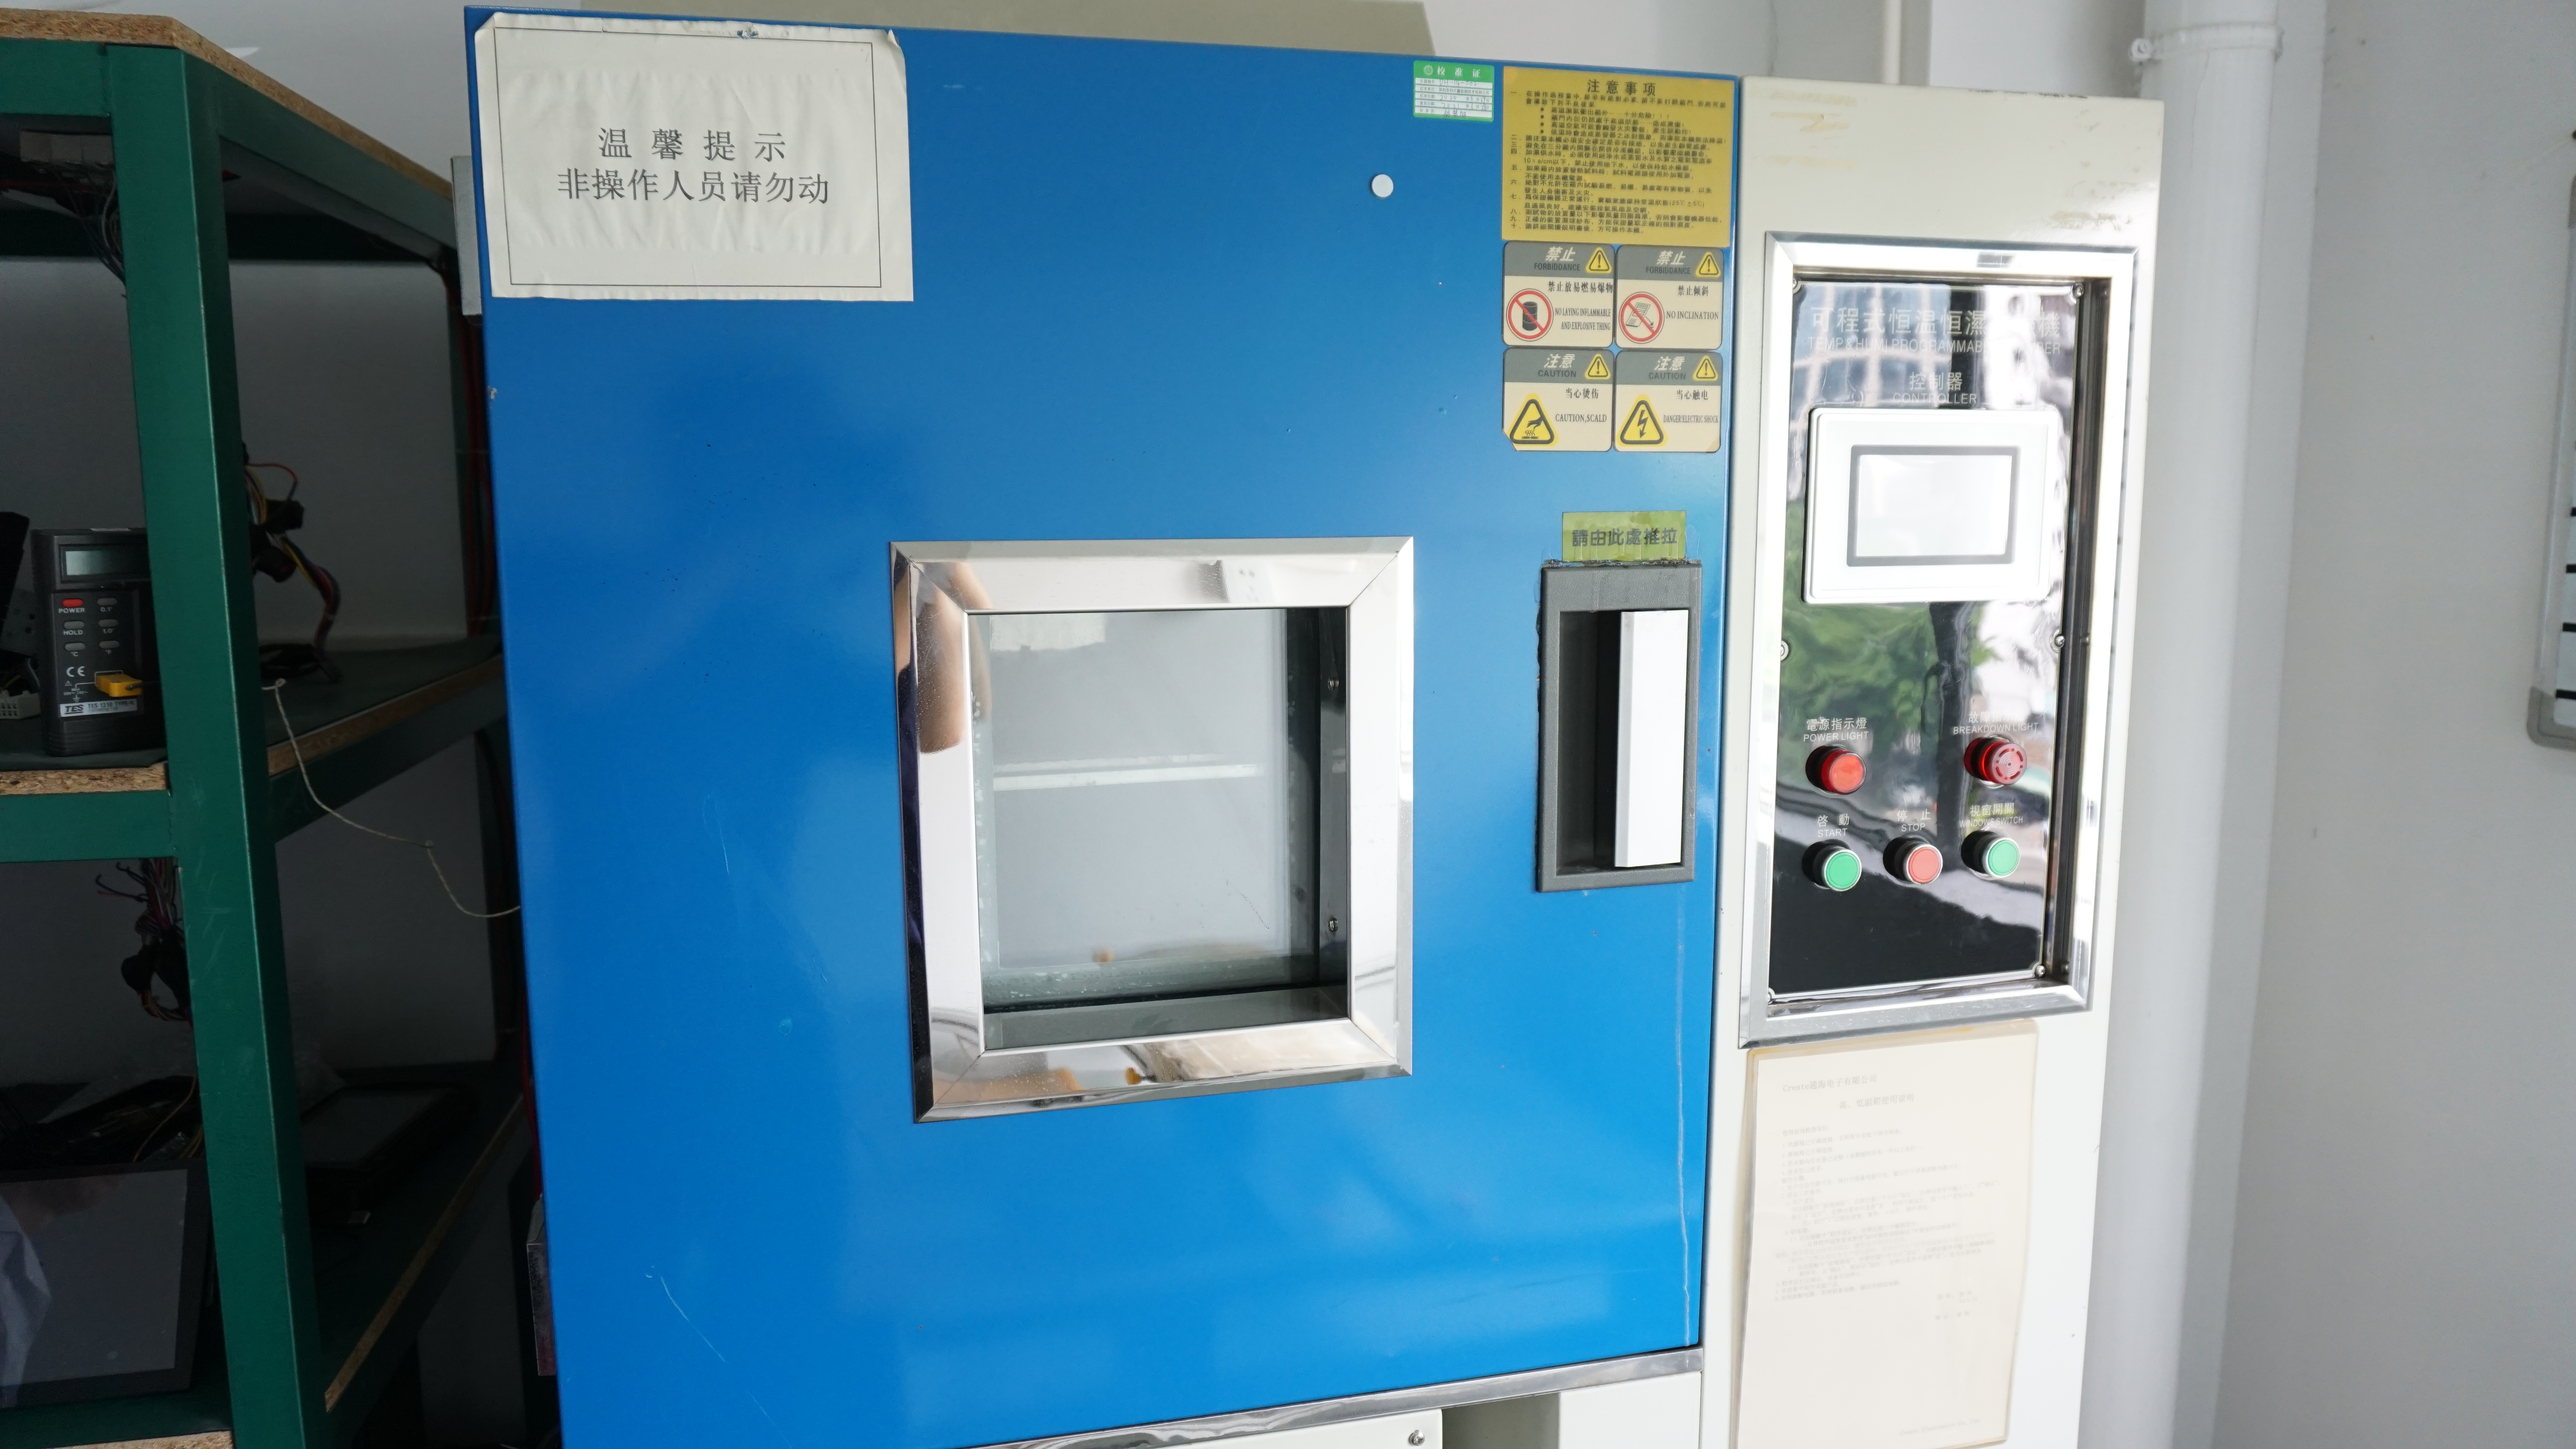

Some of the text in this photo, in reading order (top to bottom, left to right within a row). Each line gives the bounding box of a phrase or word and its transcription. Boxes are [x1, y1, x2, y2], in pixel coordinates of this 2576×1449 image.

[1437, 66, 1481, 78] 校准证
[1588, 79, 1656, 97] 注意事项
[598, 128, 786, 162] 温馨提示
[557, 168, 829, 204] 非操作人员请勿动
[1546, 246, 1576, 261] 禁止
[1657, 250, 1686, 265] 禁止
[1534, 263, 1580, 271] FORBIDDANCE
[1548, 281, 1613, 294] 禁止放易燃易爆物
[1678, 285, 1709, 297] 禁止倾斜
[1555, 307, 1611, 317] NO LAYING INFLAMMABLE
[1677, 311, 1719, 319] INCLINATION
[1561, 321, 1610, 330] AND EXPLOSIVE THING
[1810, 307, 2061, 338] 可程式恒温恒濕機
[1544, 353, 1575, 368] 注意
[1655, 356, 1685, 371] 注意
[1910, 372, 1962, 391] 控制器
[1566, 388, 1599, 399] 当心烫伤
[1677, 389, 1708, 400] 当心触电
[1893, 393, 1977, 404] CONTROLLER
[1555, 414, 1607, 423] CAUTION,SCALD
[1572, 527, 1677, 547] 請由此處推拉
[66, 666, 85, 677] CE
[1806, 717, 1867, 731] 電源指示燈
[1953, 722, 2039, 735] BREAKDOWN LIGHT
[1804, 731, 1869, 742] POWER LIGHT
[1897, 809, 1931, 822] 停止
[1970, 803, 2014, 817] 視窗開關
[1901, 823, 1926, 832] STOP
[1959, 816, 2023, 828] WINDOWS SWITCH
[1818, 828, 1847, 837] START
[1783, 1074, 1877, 1093] Create通海电子有限公司
[1839, 1093, 1914, 1110] 高、低温箱使用说明
